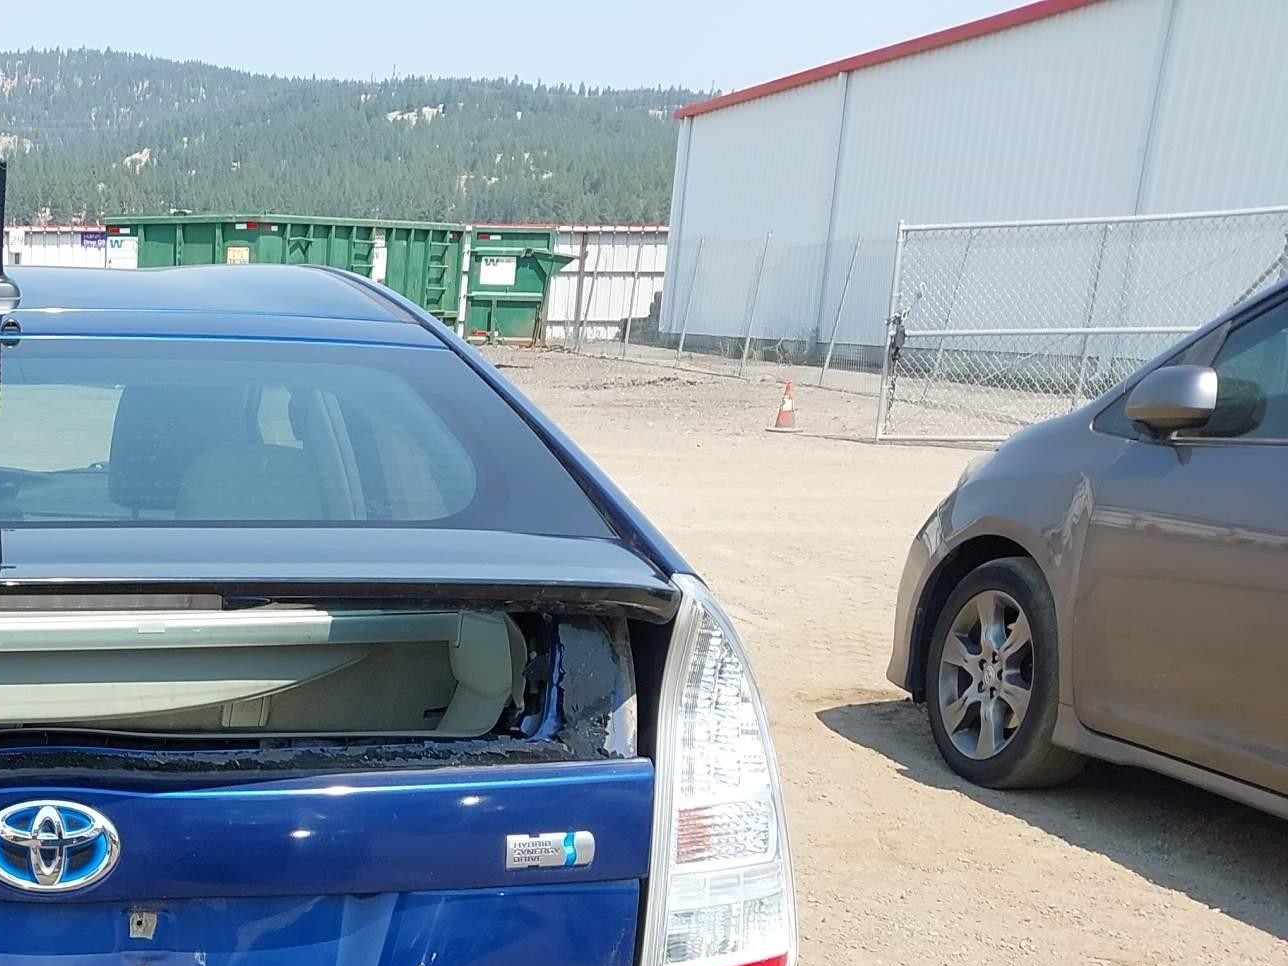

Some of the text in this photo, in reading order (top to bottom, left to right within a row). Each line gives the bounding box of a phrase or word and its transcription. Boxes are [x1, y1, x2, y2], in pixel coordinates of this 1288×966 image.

[11, 235, 24, 246] 29
[513, 840, 552, 849] HYBRID
[513, 855, 543, 863] DRIVE
